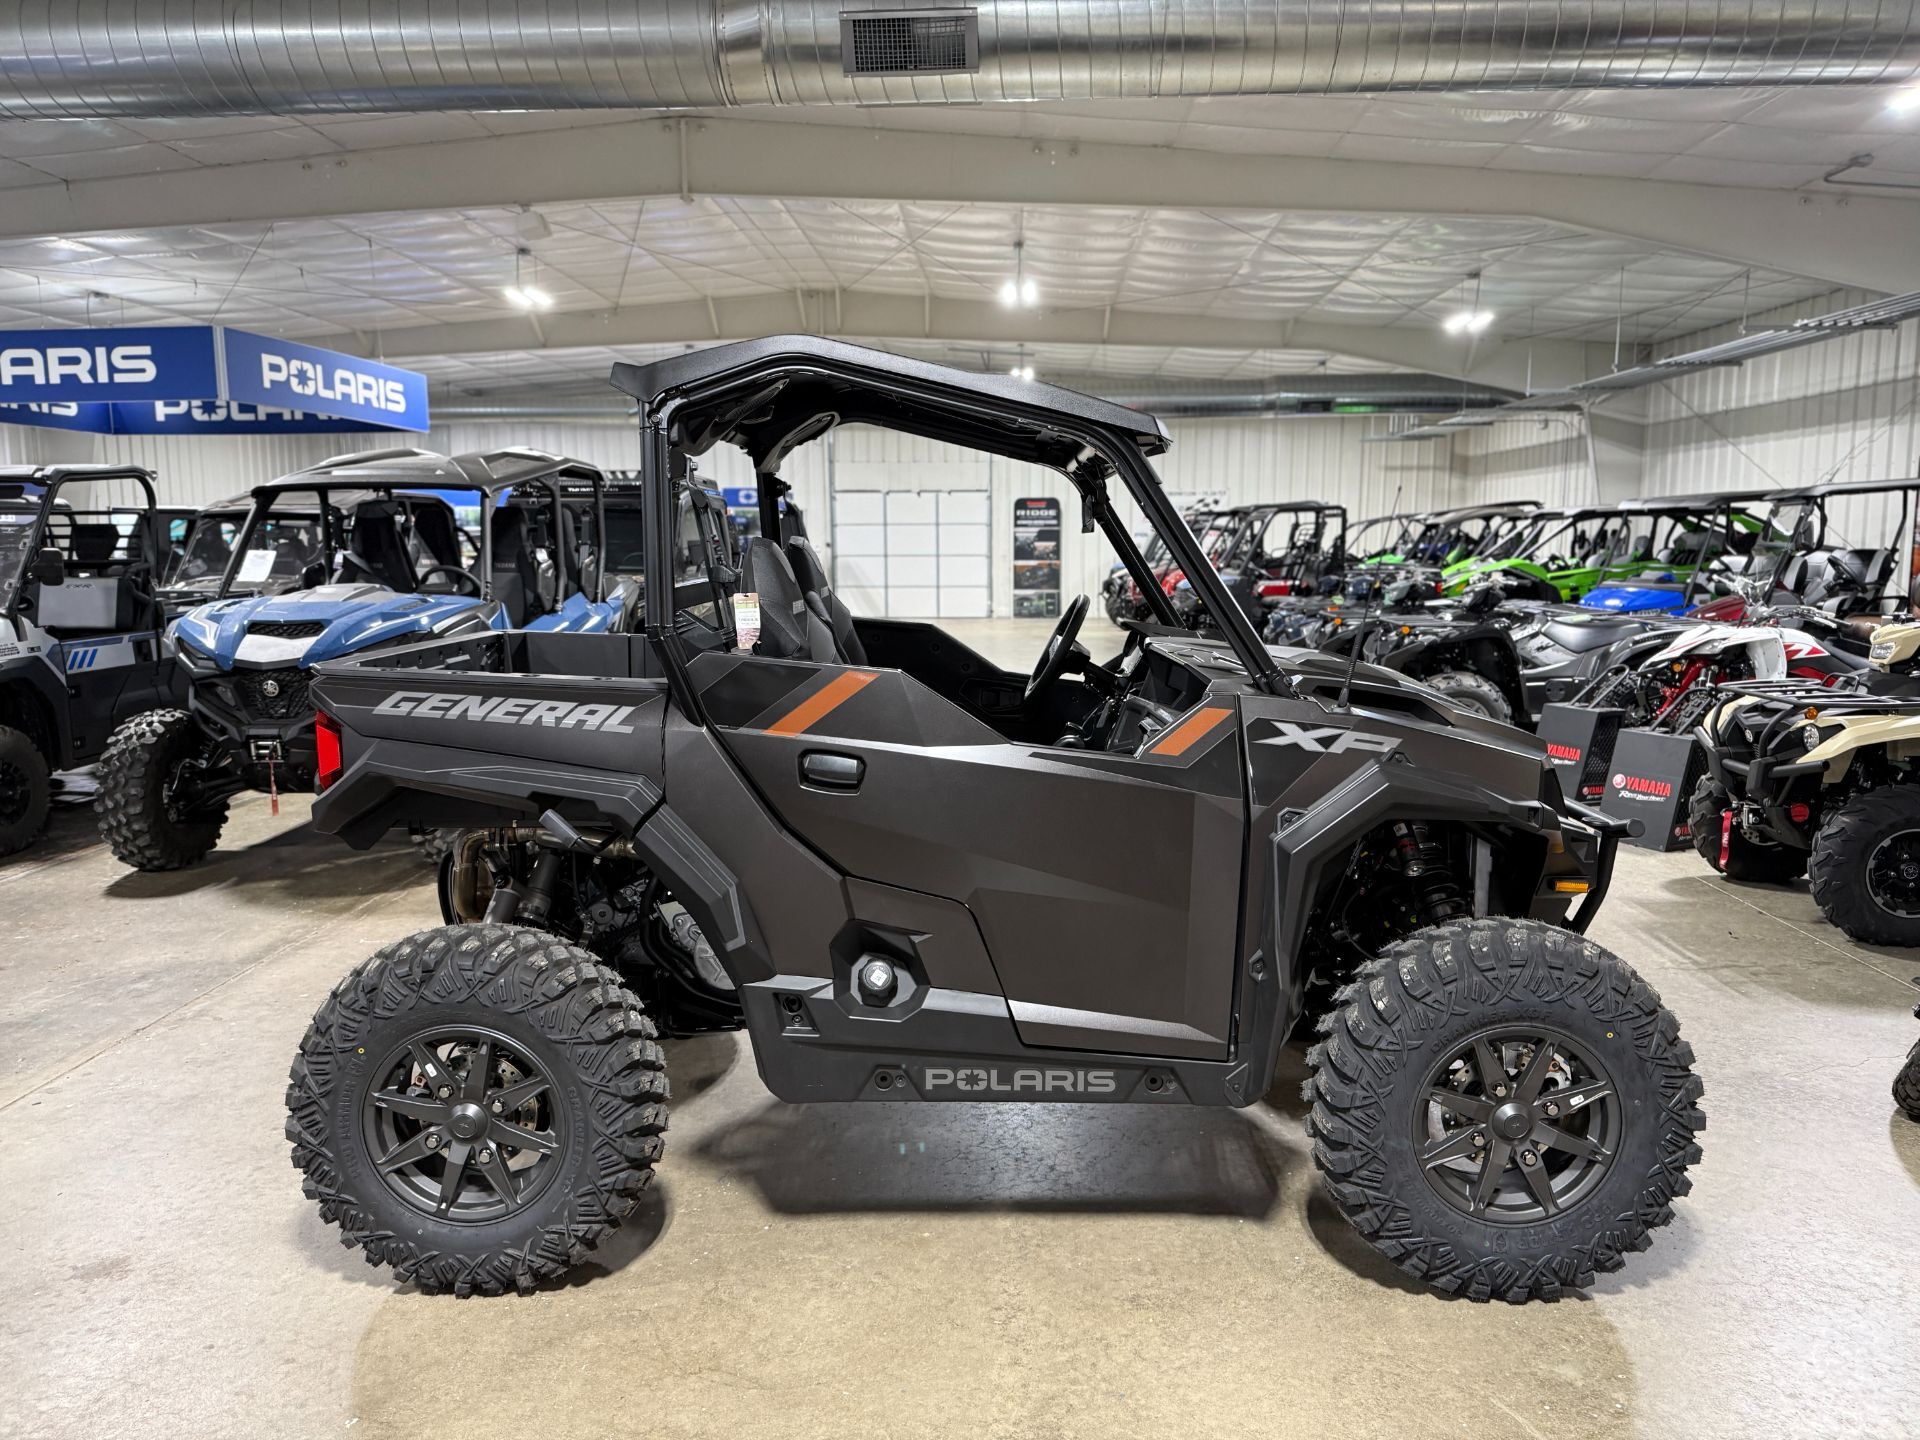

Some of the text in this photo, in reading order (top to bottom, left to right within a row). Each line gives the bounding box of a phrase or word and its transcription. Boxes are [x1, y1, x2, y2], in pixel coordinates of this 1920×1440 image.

[261, 353, 407, 413] POLARIS
[372, 690, 638, 734] GENERAL
[1547, 743, 1581, 761] YAMAHA
[1626, 776, 1671, 797] YAMAHA
[924, 1068, 1116, 1093] POLARIS
